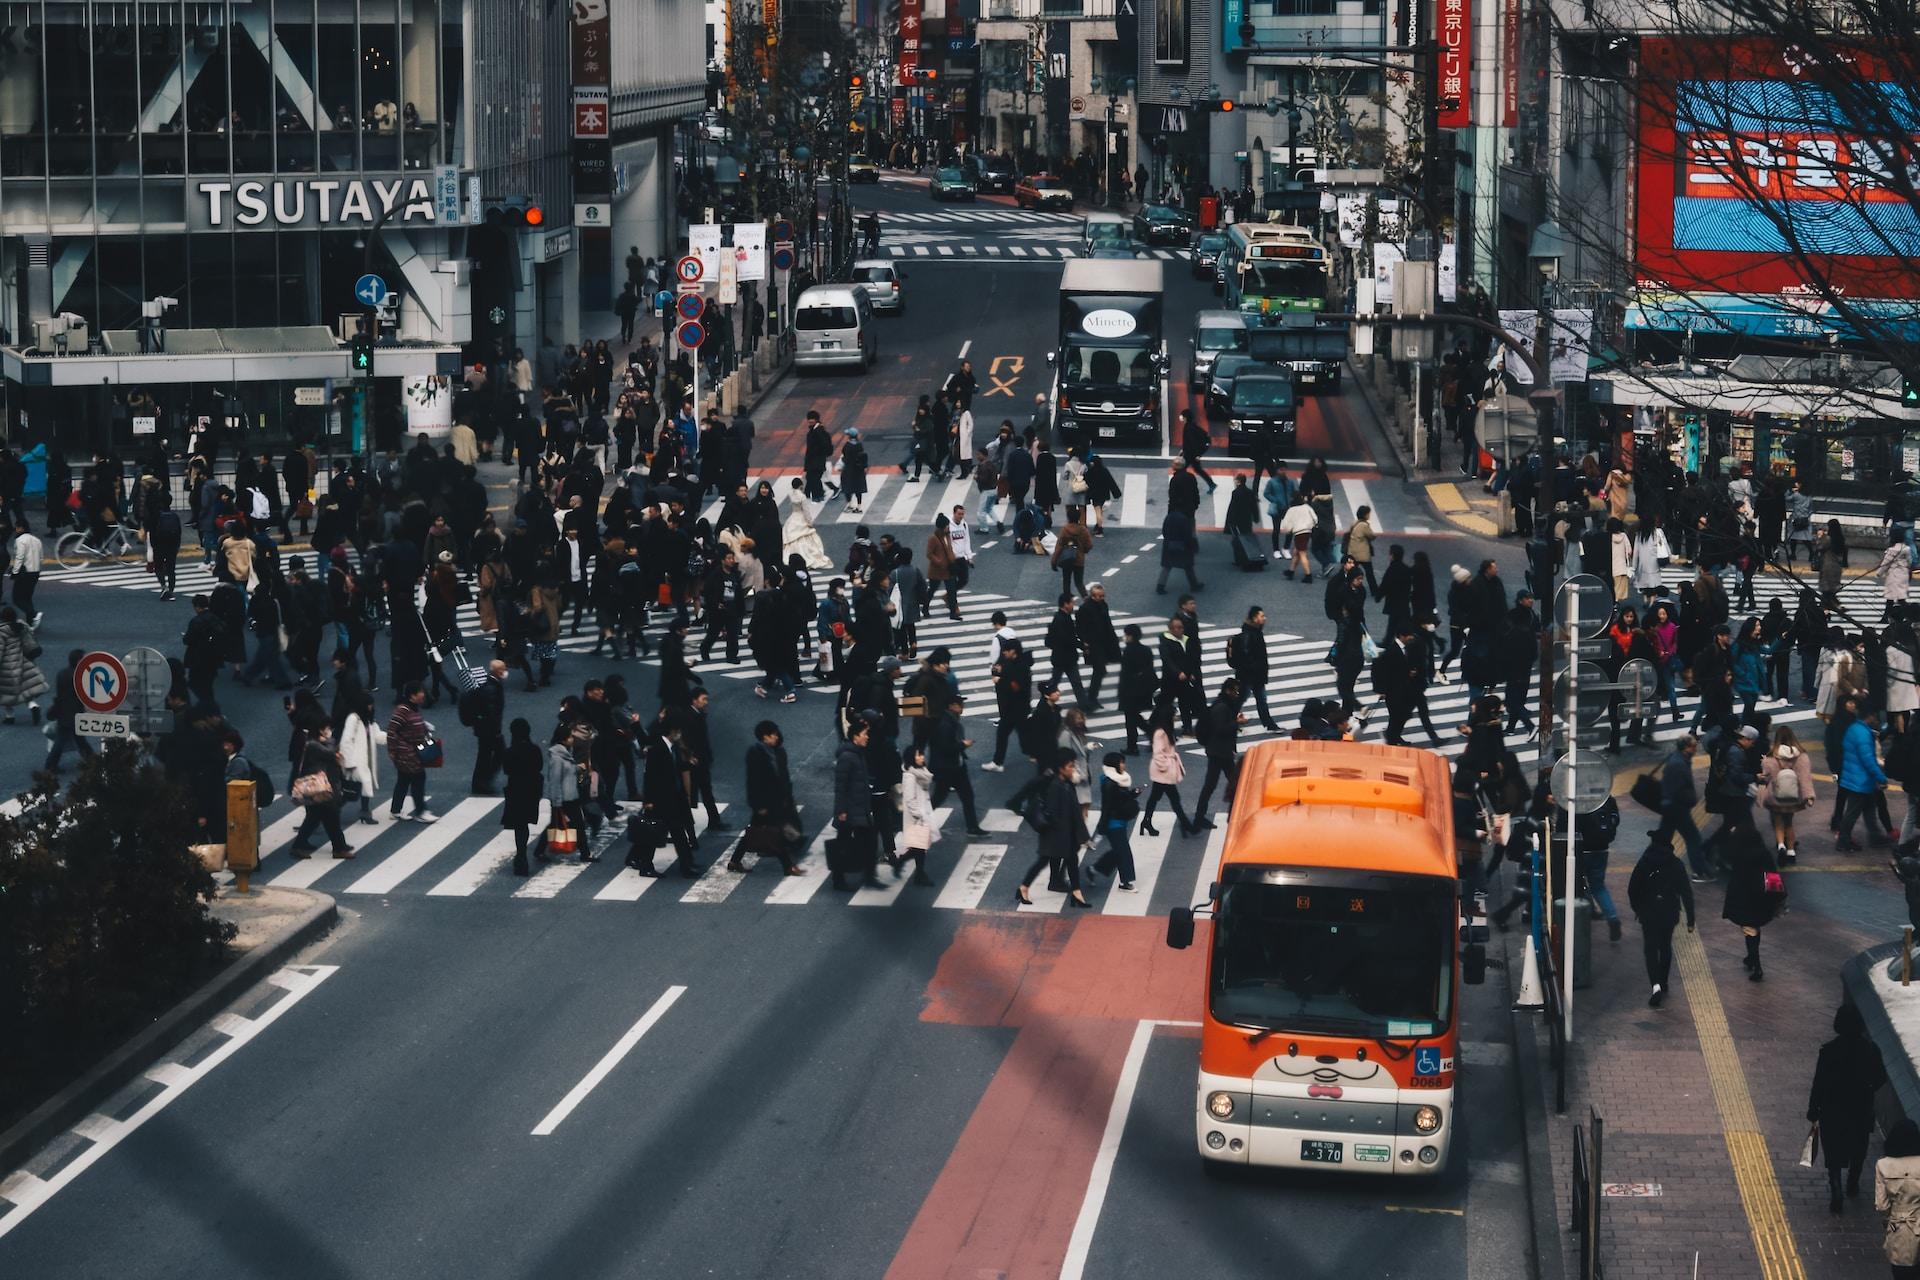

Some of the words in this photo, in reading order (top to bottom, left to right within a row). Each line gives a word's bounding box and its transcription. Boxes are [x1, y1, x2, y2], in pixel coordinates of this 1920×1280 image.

[581, 107, 603, 133] 本
[579, 160, 606, 168] WIRED
[199, 180, 436, 225] TSUTAYA
[445, 169, 458, 222] 渋谷駅前
[1087, 317, 1133, 328] Minette
[79, 719, 125, 734] ここから
